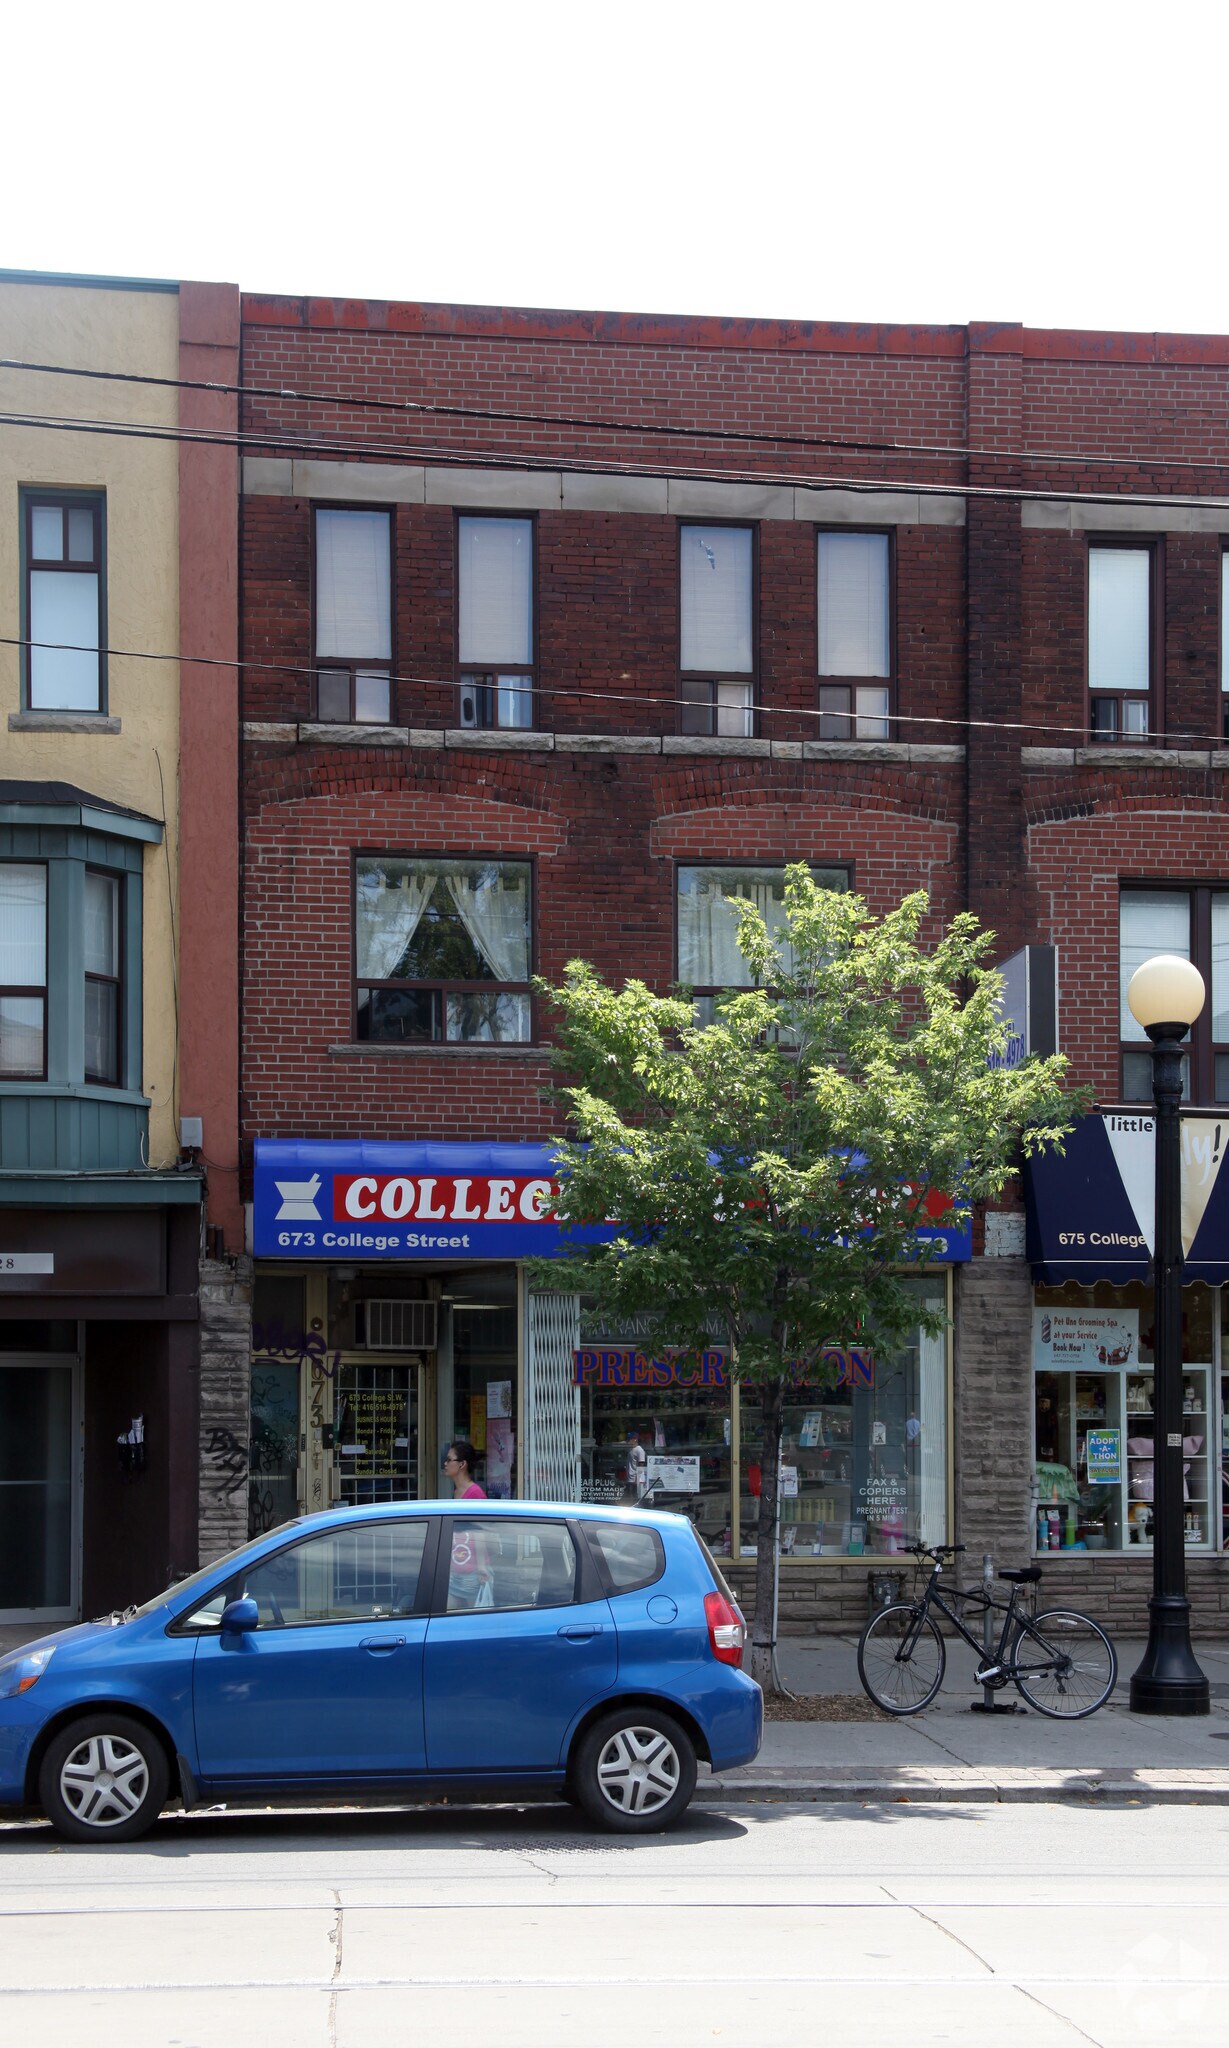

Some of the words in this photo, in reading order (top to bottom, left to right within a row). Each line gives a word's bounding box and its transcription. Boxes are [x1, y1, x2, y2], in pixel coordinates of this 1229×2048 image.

[1110, 1117, 1153, 1132] little
[278, 1232, 317, 1247] 673
[322, 1232, 400, 1249] College
[406, 1233, 470, 1248] Street
[1058, 1232, 1086, 1245] 675
[1089, 1232, 1147, 1247] College
[1054, 1316, 1064, 1325] Pet
[1078, 1317, 1105, 1328] Grooming
[1107, 1318, 1118, 1328] Spa
[1053, 1331, 1060, 1339] at
[1061, 1332, 1075, 1340] your
[1077, 1330, 1098, 1339] Service
[1053, 1342, 1067, 1351] Book
[1068, 1343, 1081, 1352] Now
[1090, 1437, 1119, 1445] ADOPT
[1093, 1452, 1117, 1460] THON
[595, 1479, 616, 1487] PLUG
[866, 1478, 887, 1486] FAX
[890, 1478, 898, 1486] &
[859, 1487, 907, 1496] COPIERS
[866, 1497, 896, 1505] HERE
[856, 1507, 891, 1515] PREGNANT
[892, 1507, 908, 1515] TEST
